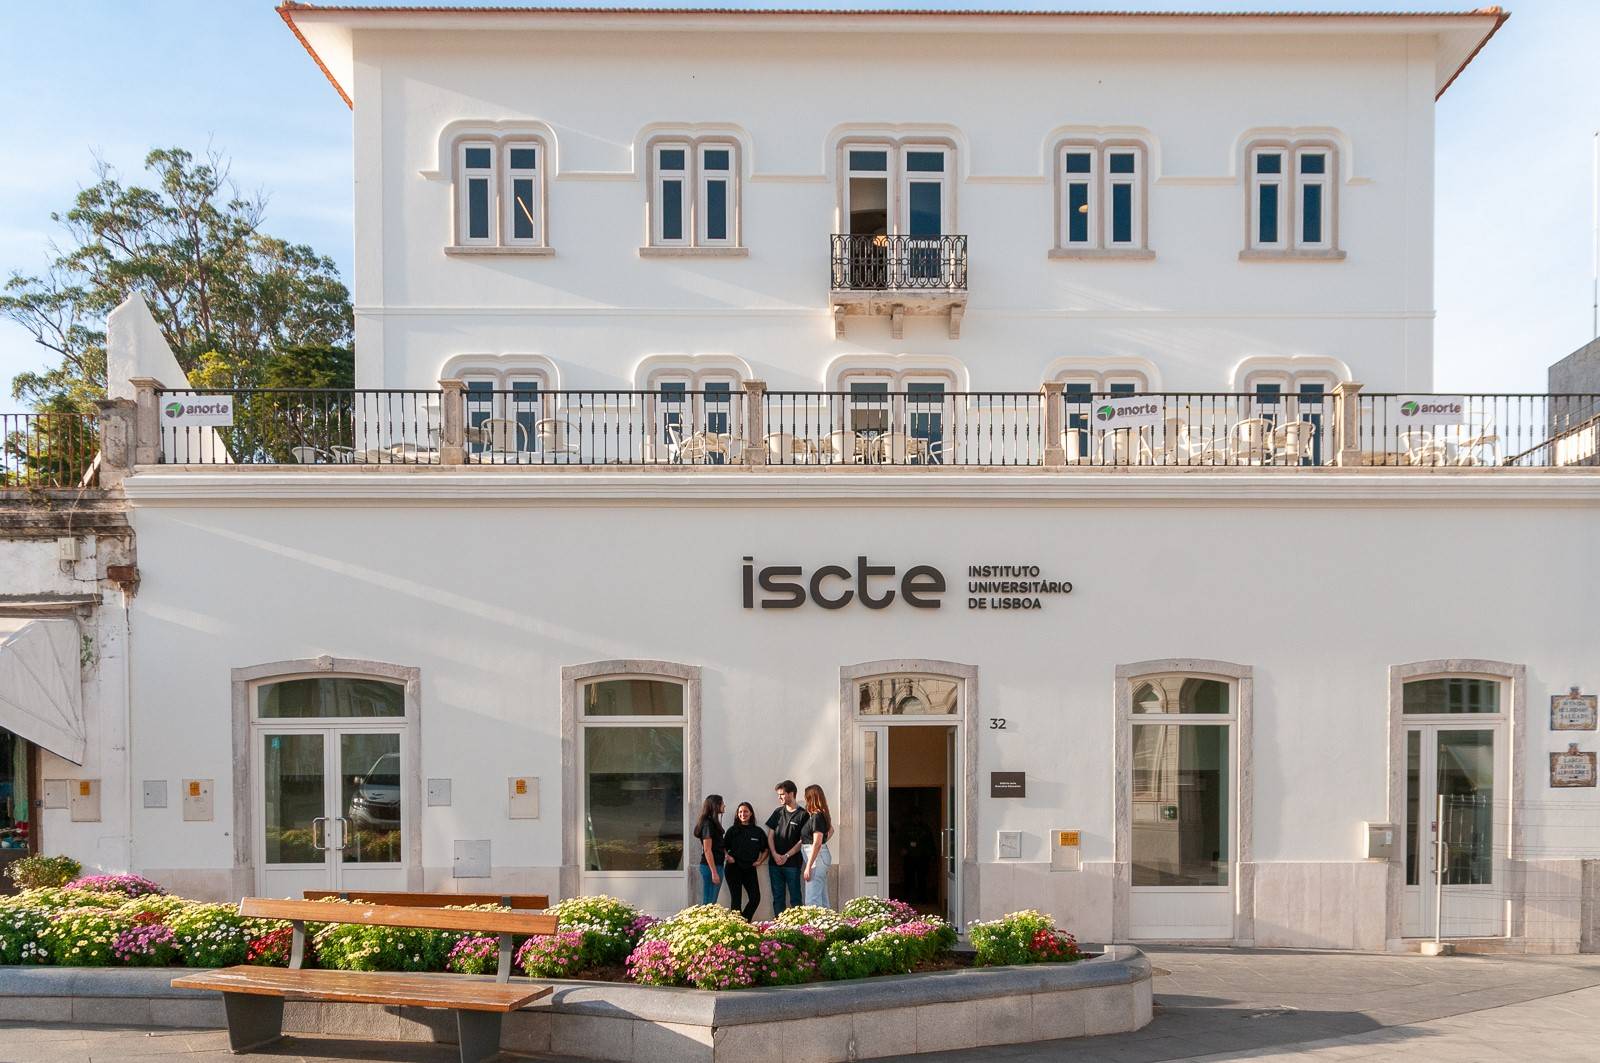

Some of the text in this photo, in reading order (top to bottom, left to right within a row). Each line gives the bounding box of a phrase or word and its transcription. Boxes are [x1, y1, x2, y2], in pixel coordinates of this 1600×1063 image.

[186, 403, 229, 414] anorte
[1117, 403, 1158, 416] anorte
[1421, 402, 1462, 413] anorte
[968, 565, 1040, 577] INSTITUTO
[742, 555, 946, 610] iscte
[968, 579, 1073, 594] UNIVERSITÁRIO
[968, 598, 1042, 609] DE LISBOA
[989, 718, 1007, 730] 32
